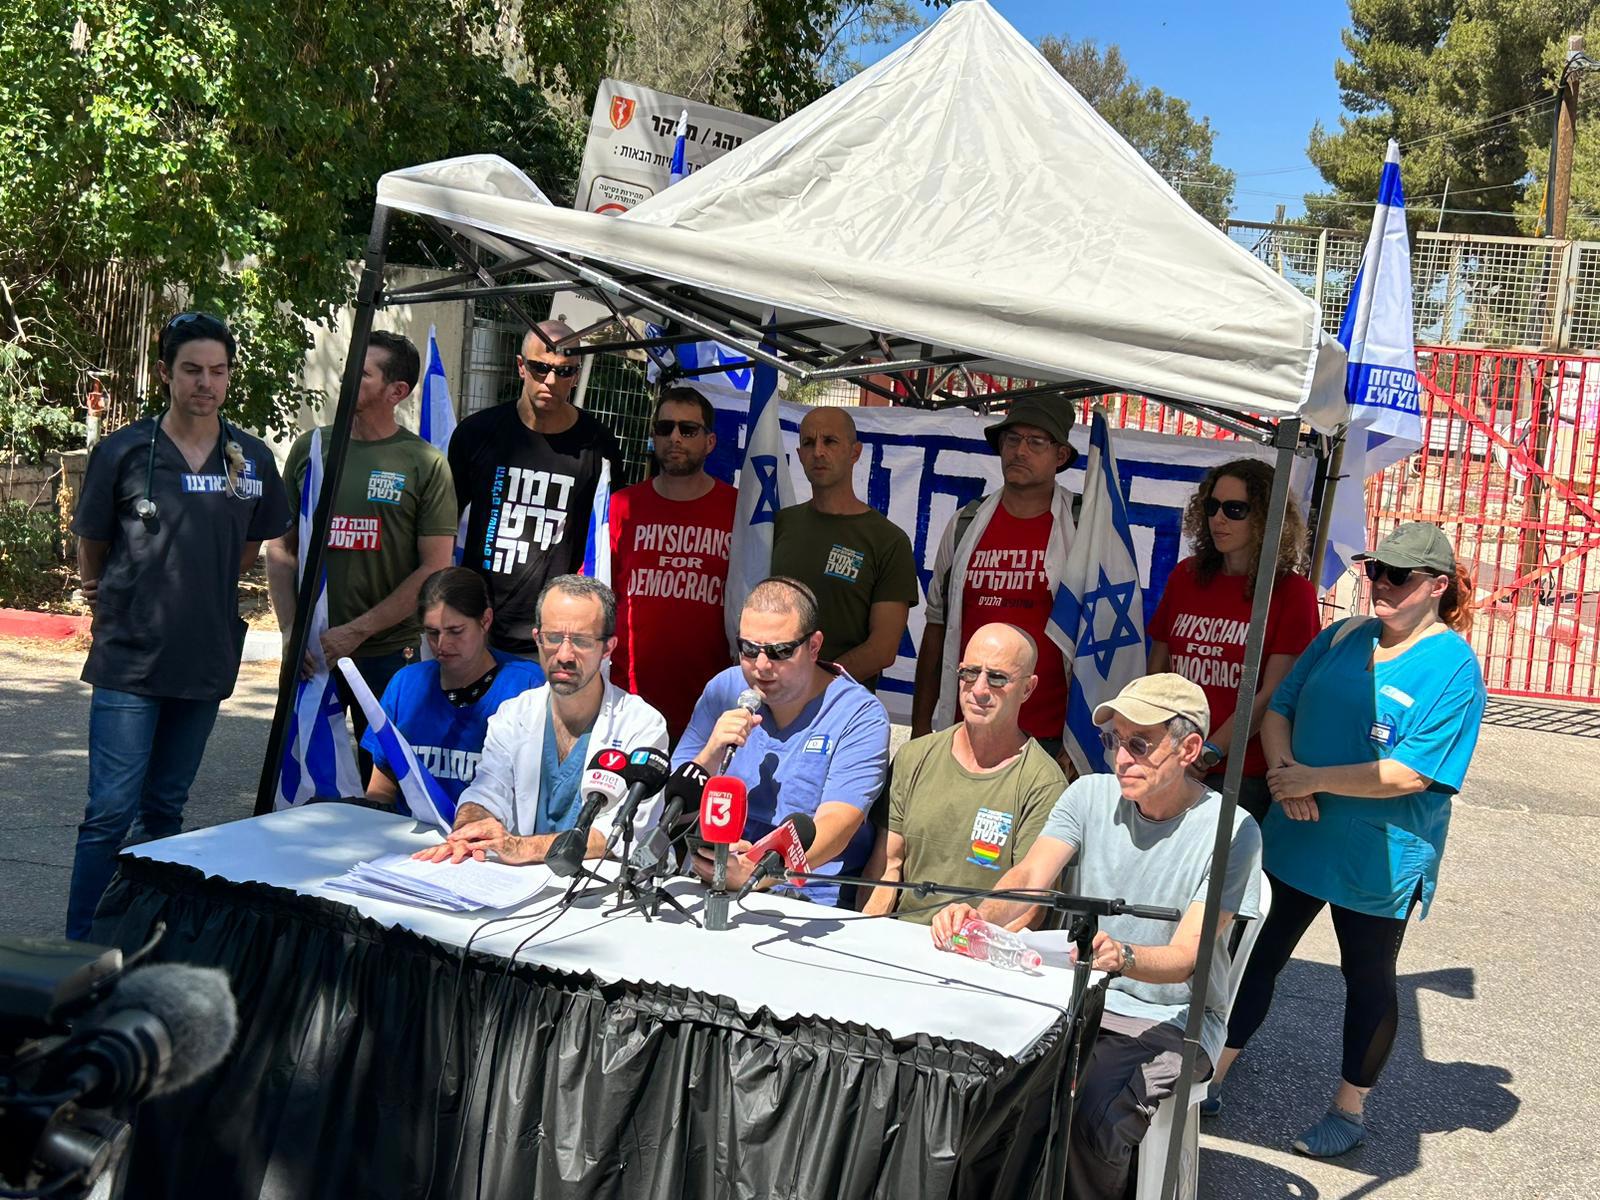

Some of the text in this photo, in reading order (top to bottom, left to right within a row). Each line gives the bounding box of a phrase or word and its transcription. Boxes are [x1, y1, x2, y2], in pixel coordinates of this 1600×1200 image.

[652, 115, 698, 142] מקר
[599, 184, 644, 200] מהירות נסיעה
[614, 194, 637, 205] מותרת
[331, 516, 379, 531] חובה לה
[634, 523, 732, 560] PHYSICIANS
[659, 555, 704, 569] FOR
[972, 549, 1045, 570] ין בריאות
[964, 570, 1036, 591] דמוקרטי
[1170, 613, 1250, 646] PHYSICIAN
[1186, 642, 1225, 657] FOR
[1171, 654, 1247, 689] EMOCRAC
[592, 771, 619, 786] ynet
[705, 796, 732, 827] 13
